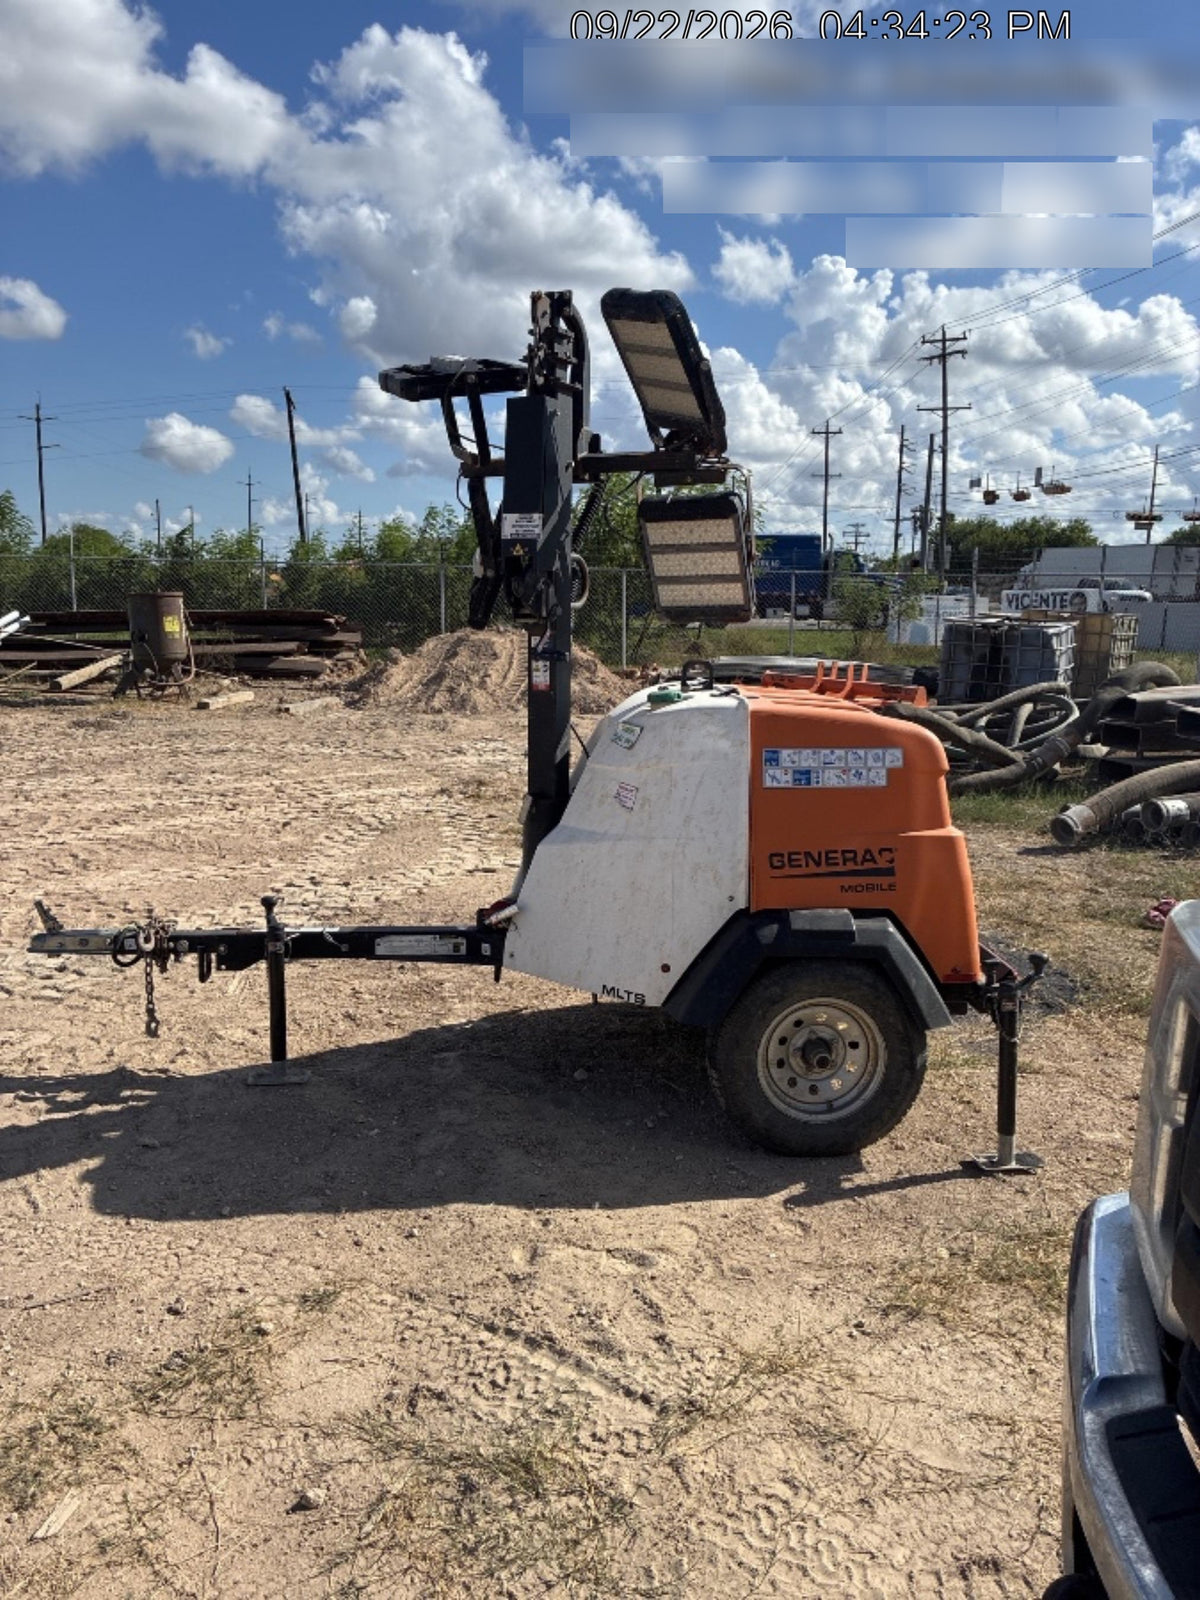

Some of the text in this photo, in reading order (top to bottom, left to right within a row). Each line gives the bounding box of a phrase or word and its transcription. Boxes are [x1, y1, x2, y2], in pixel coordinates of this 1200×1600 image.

[1006, 591, 1069, 610] VICENTE
[840, 882, 897, 893] MOBILE
[602, 984, 646, 1006] MLTS
